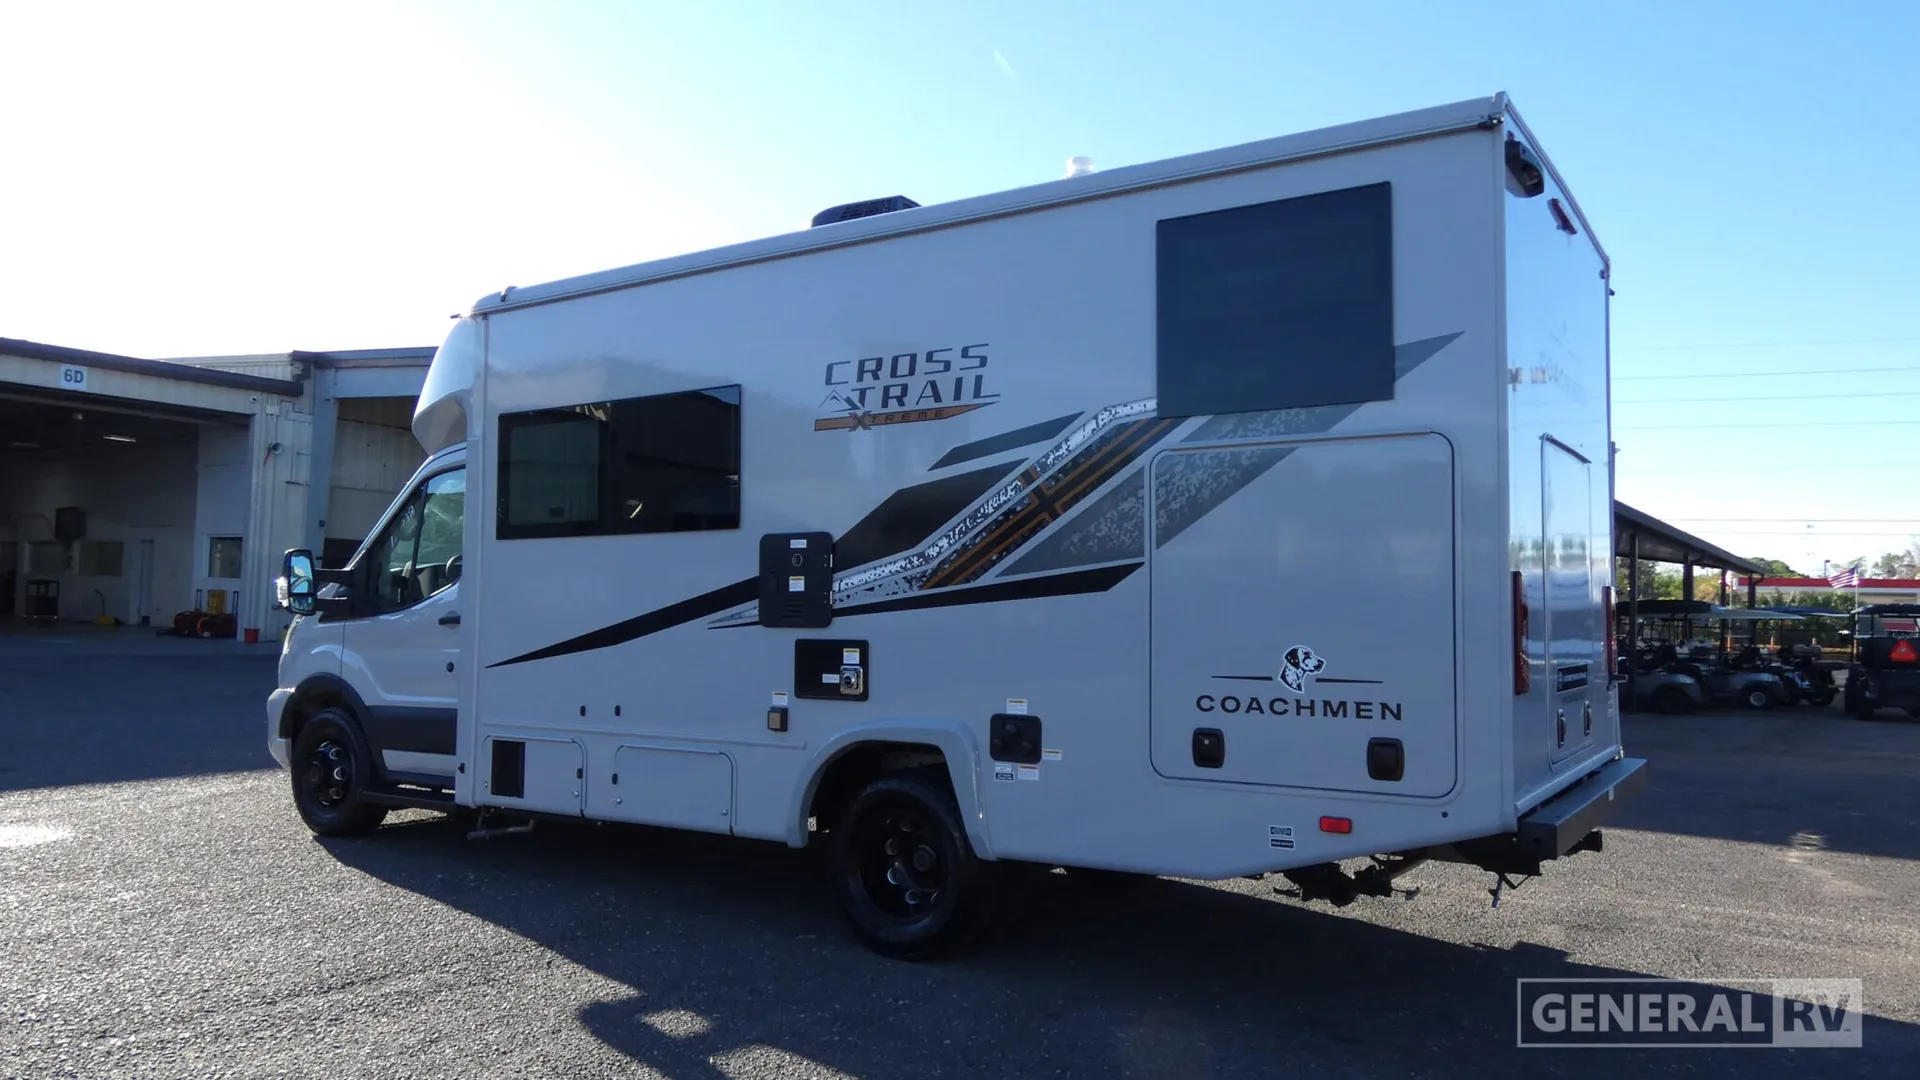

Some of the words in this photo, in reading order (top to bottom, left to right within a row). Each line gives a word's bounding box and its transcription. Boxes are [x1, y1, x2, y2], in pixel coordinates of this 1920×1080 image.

[64, 368, 84, 384] 6D
[824, 343, 990, 386] CROSS
[850, 374, 1001, 409] TRAIL
[848, 408, 946, 432] XTREME
[1196, 694, 1402, 721] COACHMEN
